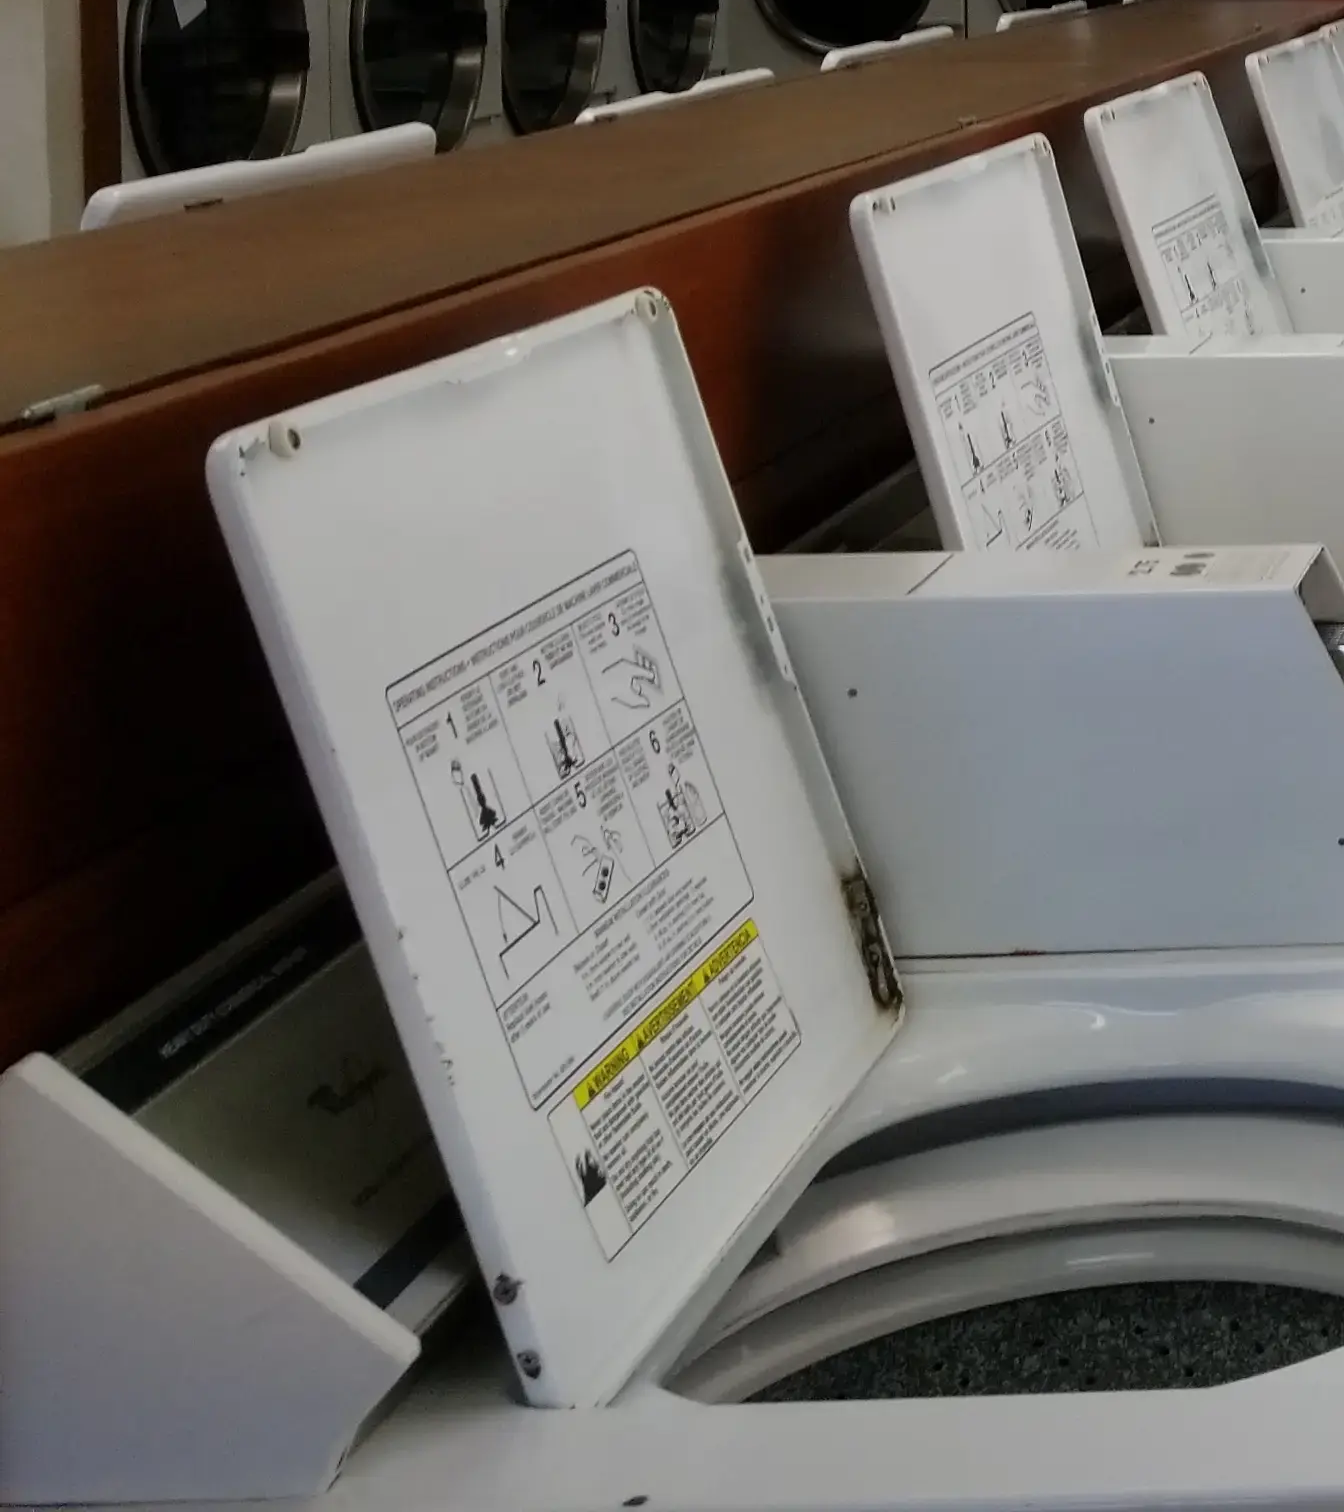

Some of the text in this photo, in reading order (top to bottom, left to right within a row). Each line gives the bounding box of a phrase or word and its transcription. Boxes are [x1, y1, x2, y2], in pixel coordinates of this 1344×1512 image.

[607, 612, 621, 637] 3
[531, 659, 547, 687] 2
[446, 711, 458, 739] 1
[648, 730, 661, 755] 6
[574, 781, 587, 808] 5
[494, 843, 505, 871] 4
[594, 1046, 631, 1090] WARNING
